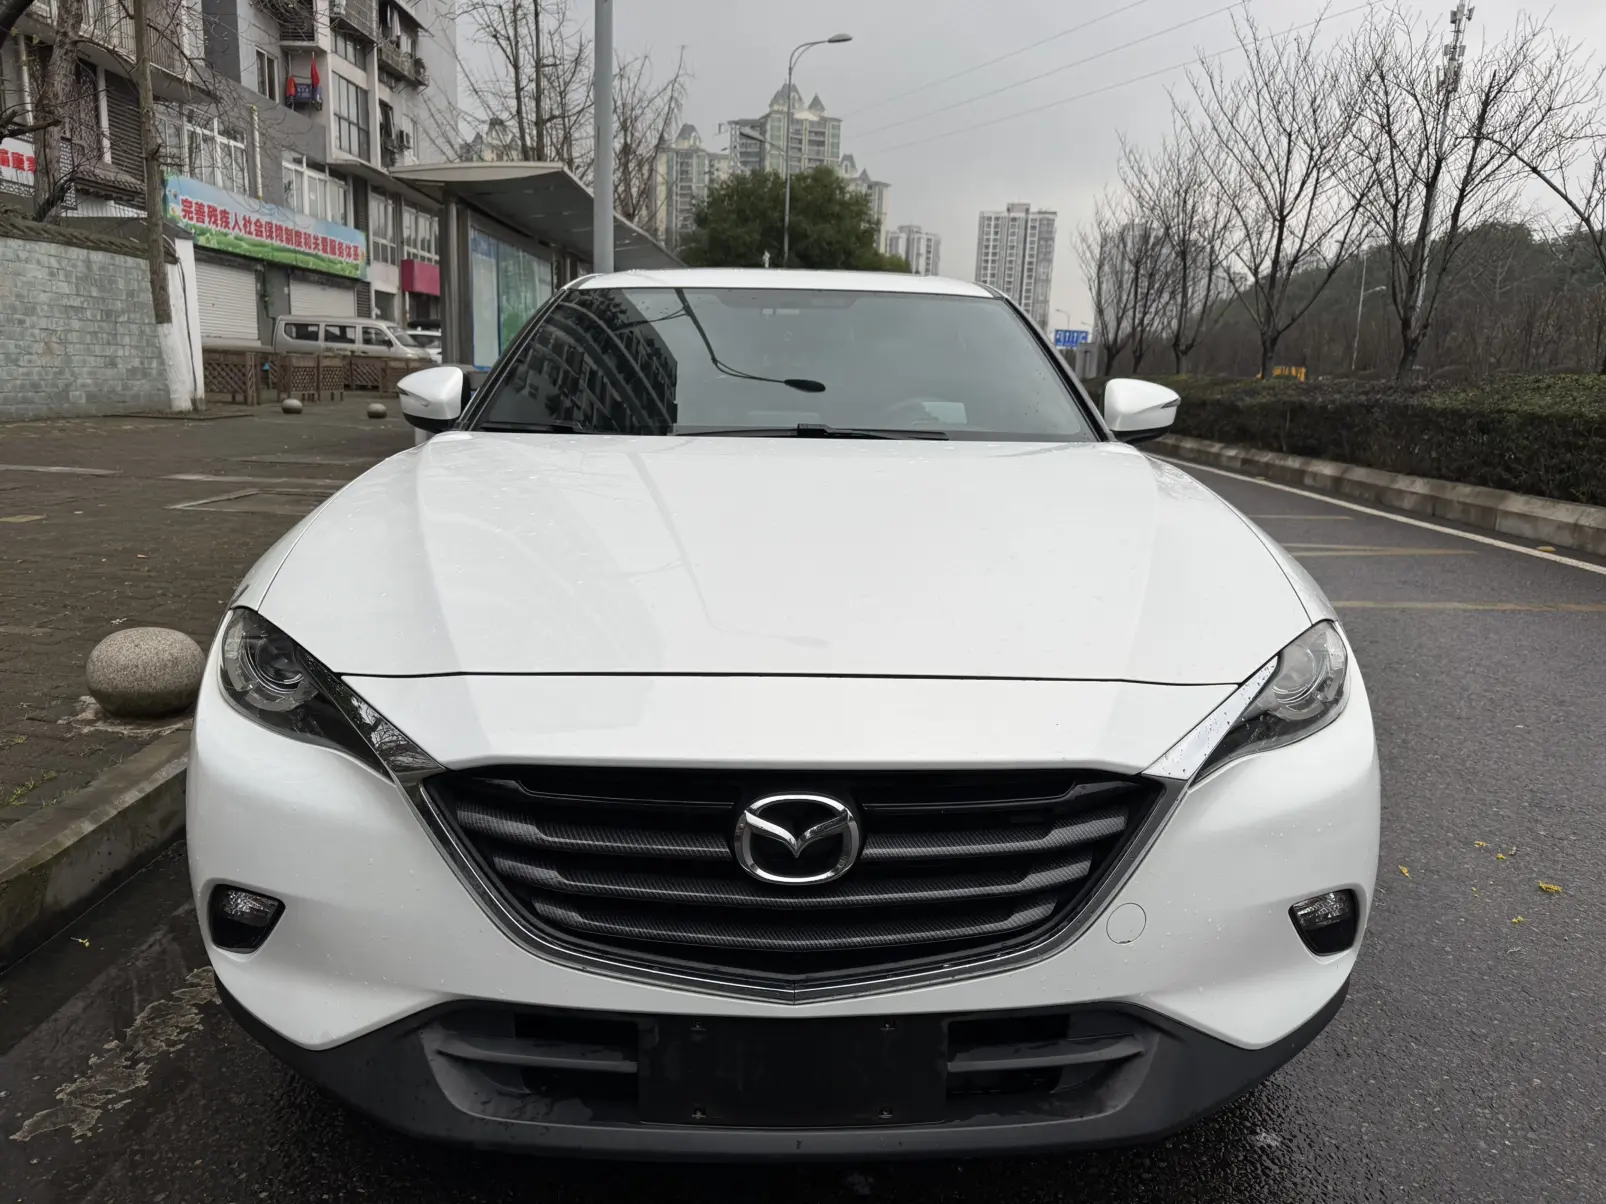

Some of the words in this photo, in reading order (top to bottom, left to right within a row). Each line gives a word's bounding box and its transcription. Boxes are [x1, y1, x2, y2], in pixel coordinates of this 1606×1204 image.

[181, 198, 360, 261] 完善残疾人社会保障制度和关爱服务体系
